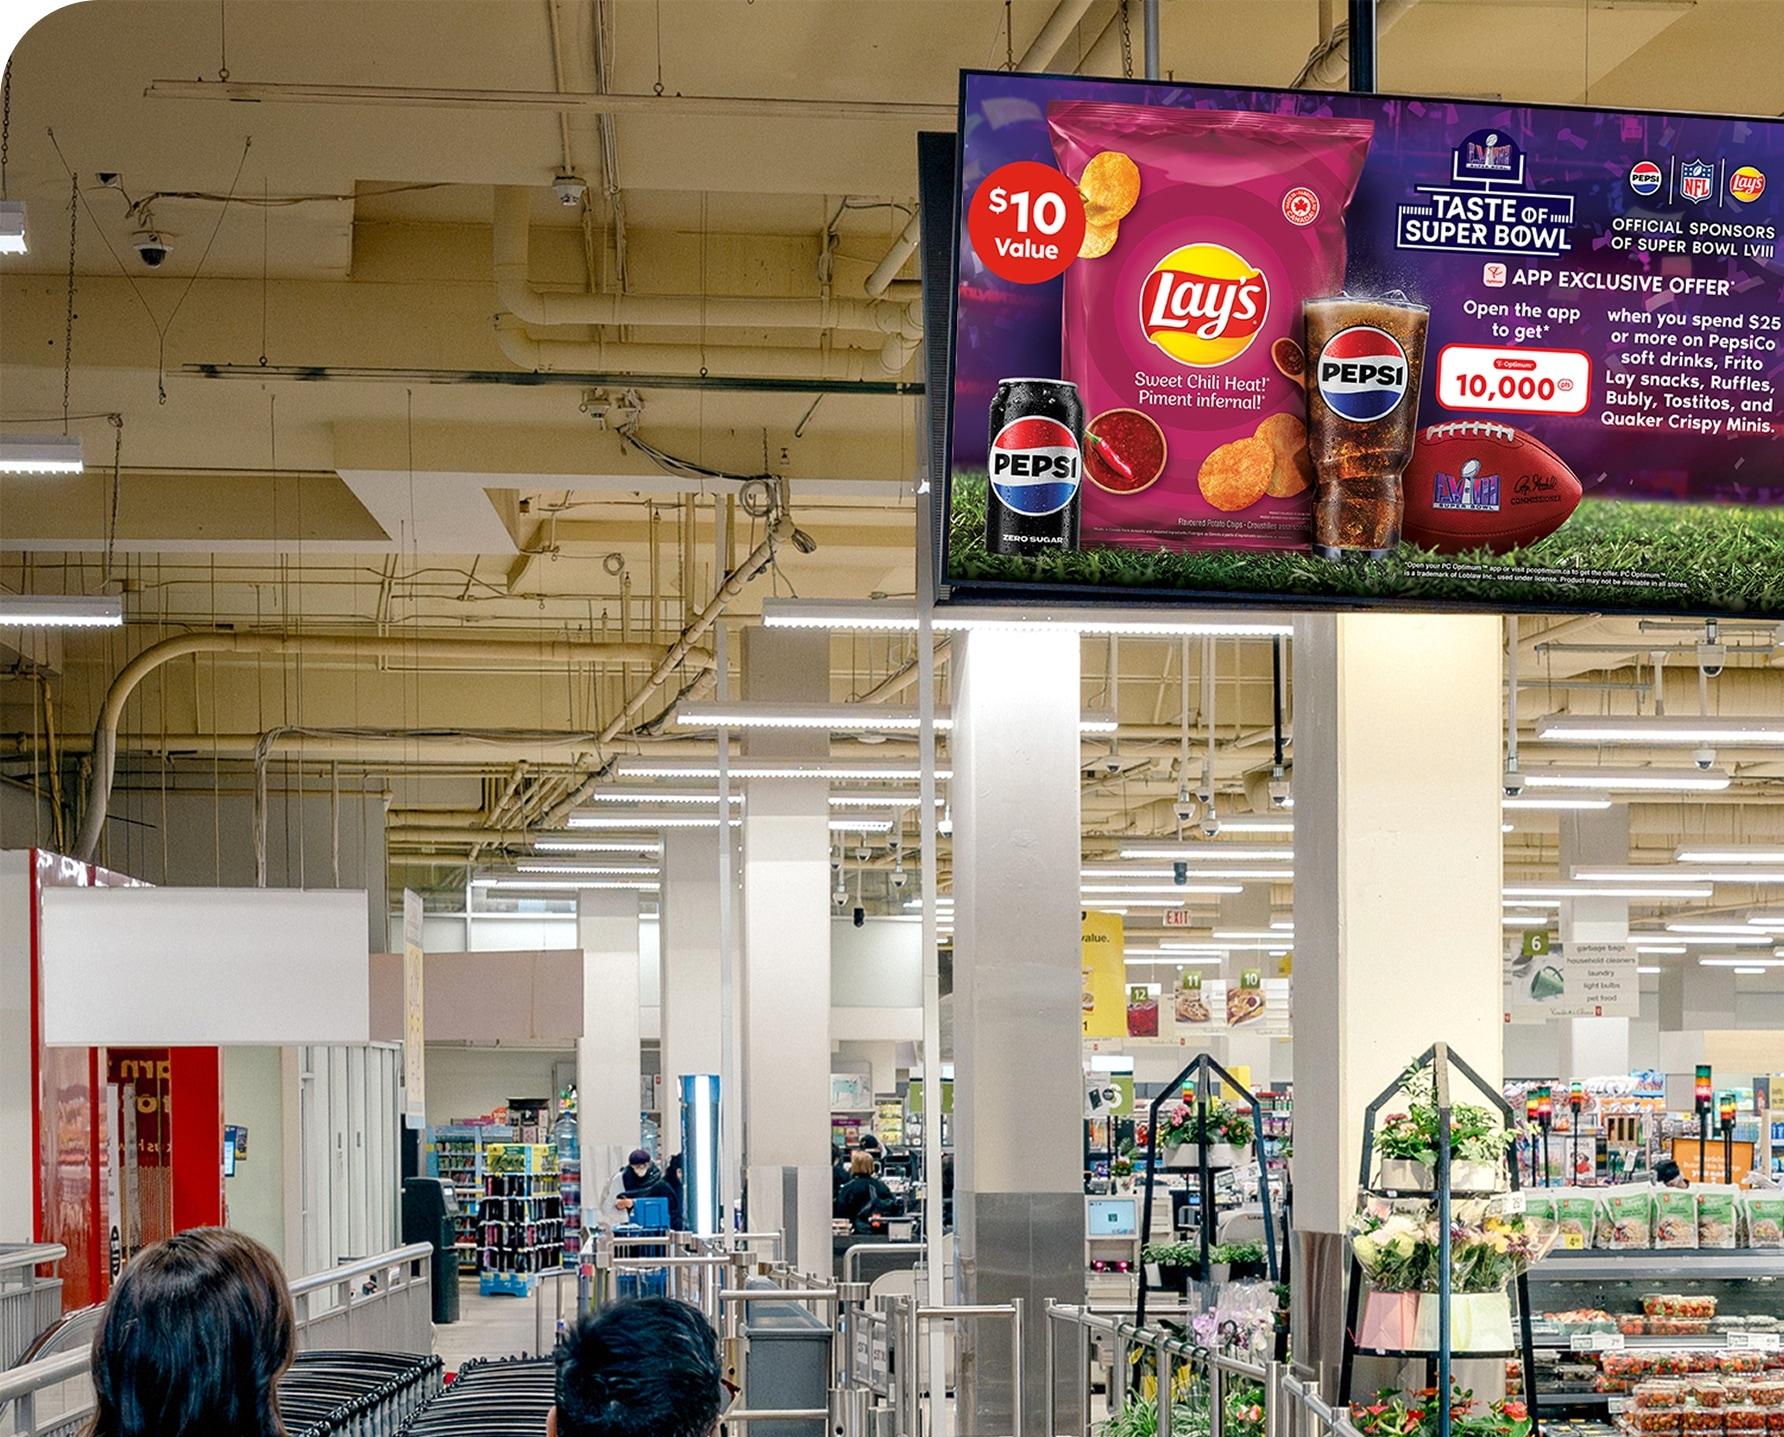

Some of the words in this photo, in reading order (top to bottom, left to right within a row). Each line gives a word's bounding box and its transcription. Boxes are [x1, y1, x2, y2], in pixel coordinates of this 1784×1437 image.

[1632, 173, 1660, 183] PEPSI
[1683, 178, 1710, 198] NFL
[1731, 172, 1764, 194] Lay's
[988, 186, 1067, 236] $10
[1433, 194, 1517, 223] TASTE
[1521, 206, 1549, 224] OF
[1405, 219, 1487, 245] SUPER
[1493, 223, 1572, 250] BOWL
[1612, 217, 1684, 235] OFFICIAL
[1688, 222, 1776, 240] SPONSORS
[994, 237, 1059, 261] Value
[1611, 237, 1633, 251] OF
[1637, 238, 1687, 254] SUPER
[1691, 240, 1740, 257] BOWL
[1743, 242, 1775, 258] LVIII
[1511, 268, 1552, 287] APP
[1558, 271, 1663, 293] EXCLUSIVE
[1148, 271, 1262, 341] Lay's
[1463, 299, 1509, 319] Open
[1514, 302, 1542, 317] the
[1547, 306, 1581, 324] app
[1491, 322, 1510, 338] to
[1607, 308, 1651, 325] when
[1656, 312, 1688, 328] you
[1692, 313, 1744, 331] spend
[1749, 314, 1782, 331] $25
[1610, 331, 1629, 344] or
[1634, 333, 1678, 347] more
[1683, 335, 1704, 348] on
[1708, 334, 1777, 354] PepsiCo
[1620, 351, 1655, 366] soft
[1660, 351, 1719, 371] drinks,
[1724, 354, 1764, 371] Frito
[1134, 371, 1183, 388] Sweet
[1187, 373, 1220, 390] Chili
[1322, 363, 1404, 386] PEPSI
[1606, 371, 1636, 389] Lay
[1640, 373, 1706, 391] snacks,
[1710, 375, 1776, 394] Ruffles,
[1138, 389, 1193, 407] Piment
[1456, 374, 1555, 401] 10,000
[1606, 391, 1658, 411] Bubly,
[1664, 393, 1735, 413] Tostitos,
[1741, 397, 1774, 413] and
[1601, 411, 1664, 428] Quaker
[1668, 415, 1722, 434] Crispy
[1726, 417, 1776, 433] Minis.
[994, 453, 1077, 479] PEPSI
[1003, 534, 1028, 543] ZERO
[1030, 535, 1063, 544] SUGAR
[1559, 576, 1585, 584] Product
[1591, 569, 1602, 577] the
[1166, 910, 1189, 925] EXIT
[1531, 935, 1542, 951] 6
[1187, 975, 1200, 986] 11
[1244, 972, 1258, 986] 10
[1588, 970, 1615, 978] laundry
[1134, 989, 1147, 1001] 12
[1584, 982, 1600, 990] light
[1586, 995, 1599, 1003] pet
[1600, 994, 1617, 1002] food
